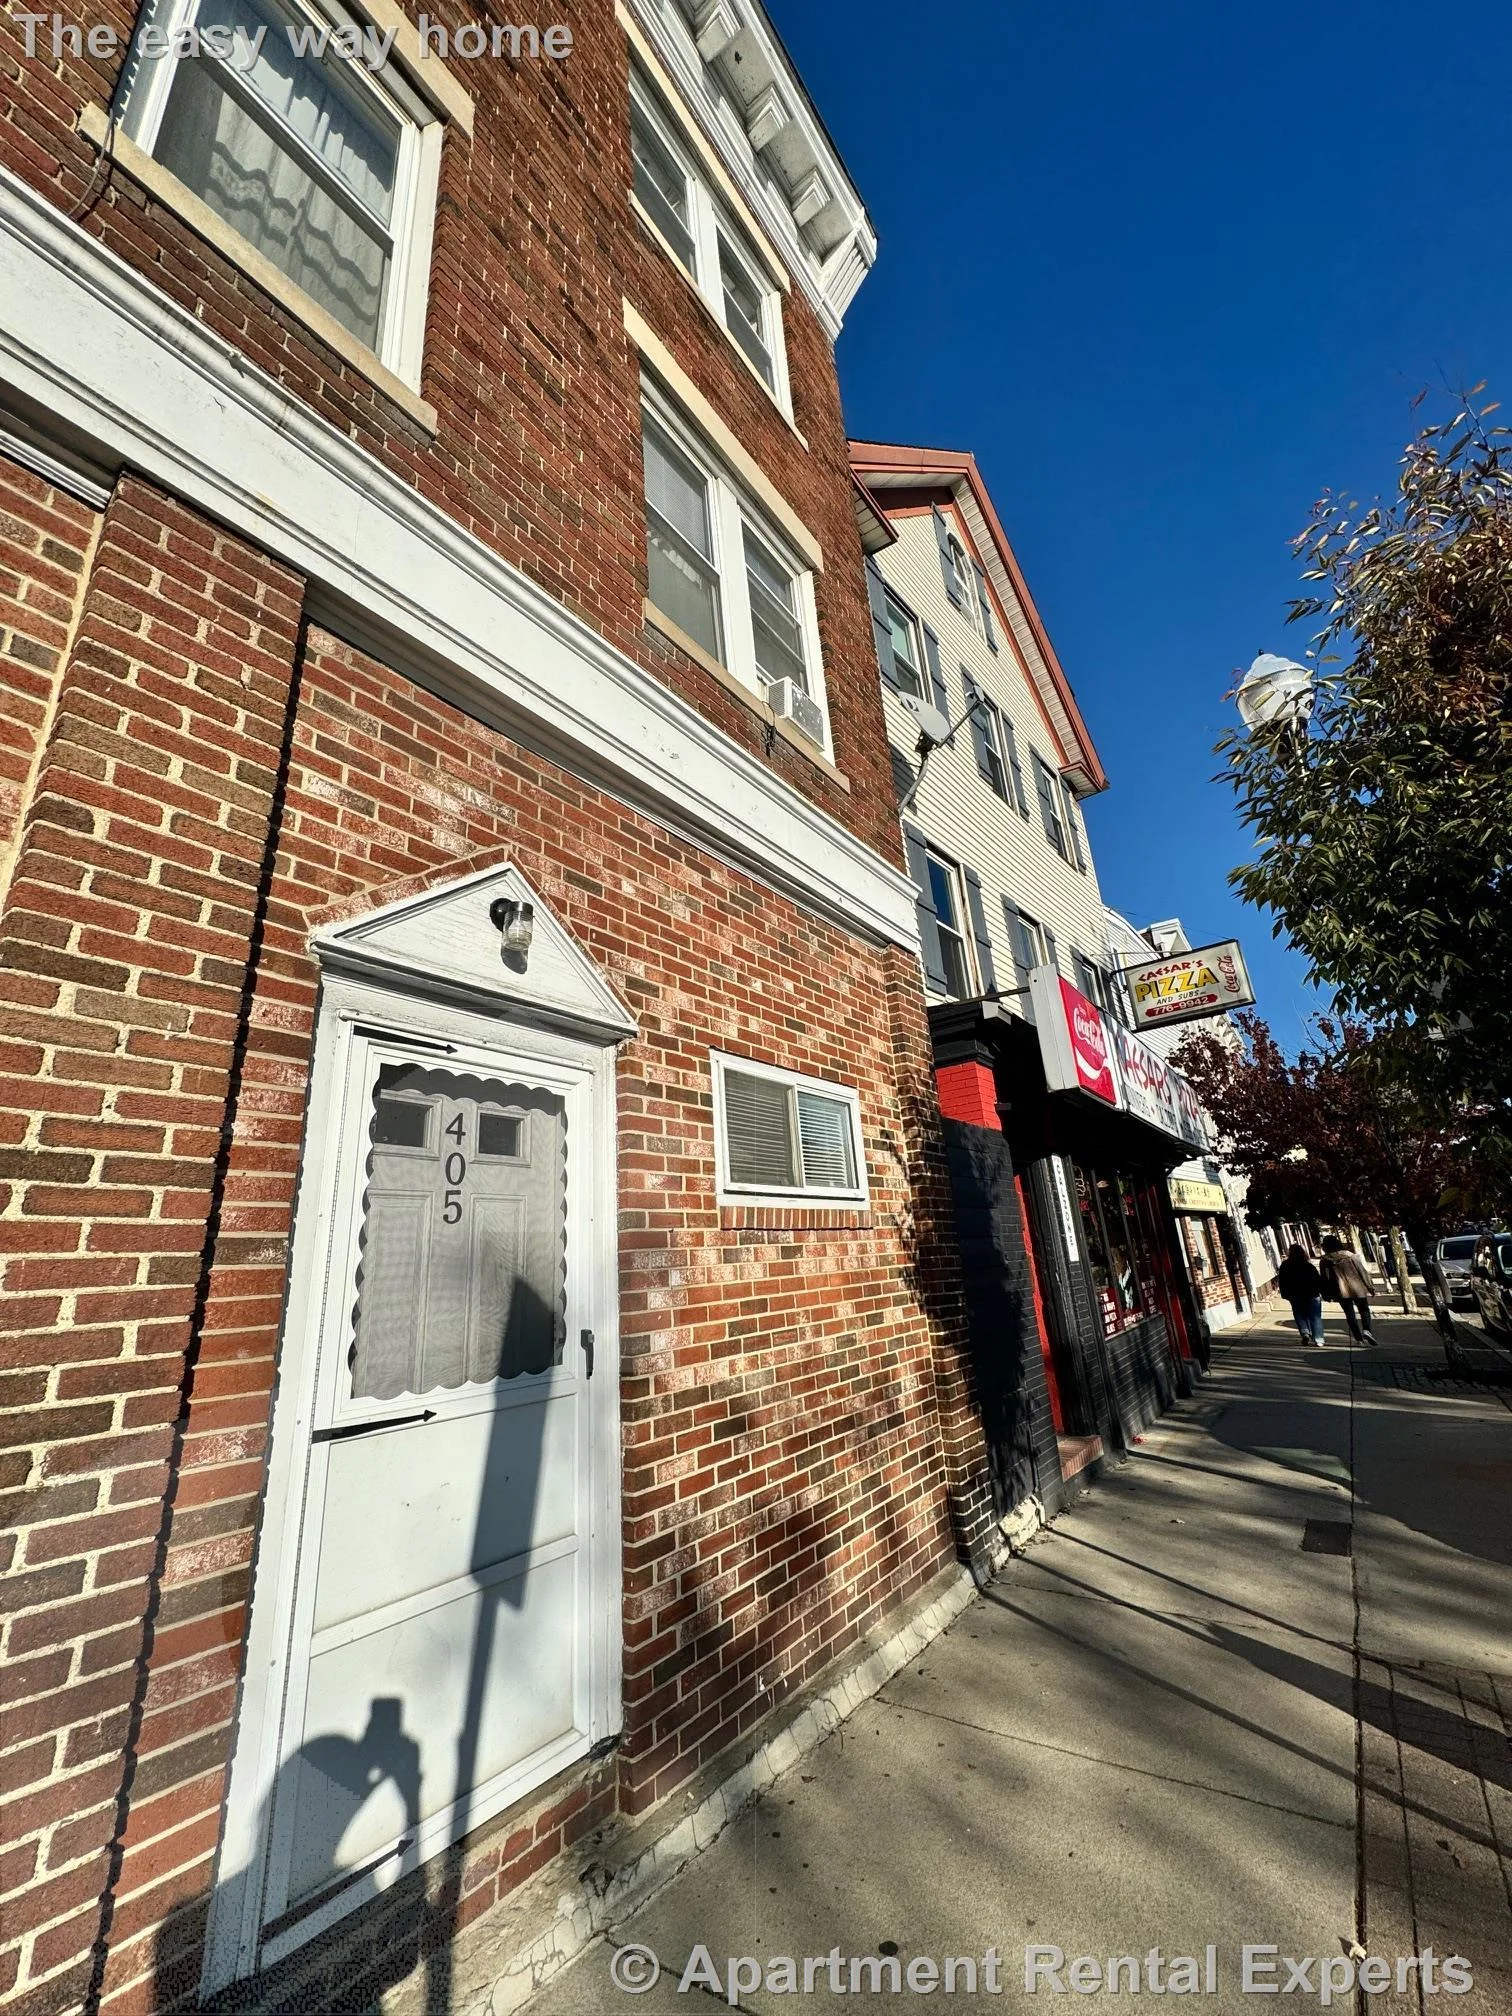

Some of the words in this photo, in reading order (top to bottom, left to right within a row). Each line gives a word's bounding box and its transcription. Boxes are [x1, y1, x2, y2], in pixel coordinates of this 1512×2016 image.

[1138, 959, 1204, 982] CAESAR'S
[1134, 967, 1219, 1002] PIZZA
[1153, 996, 1209, 1015] 776-9942
[1156, 996, 1174, 1006] AND
[1178, 989, 1200, 1000] SUBS
[442, 1112, 467, 1225] 405
